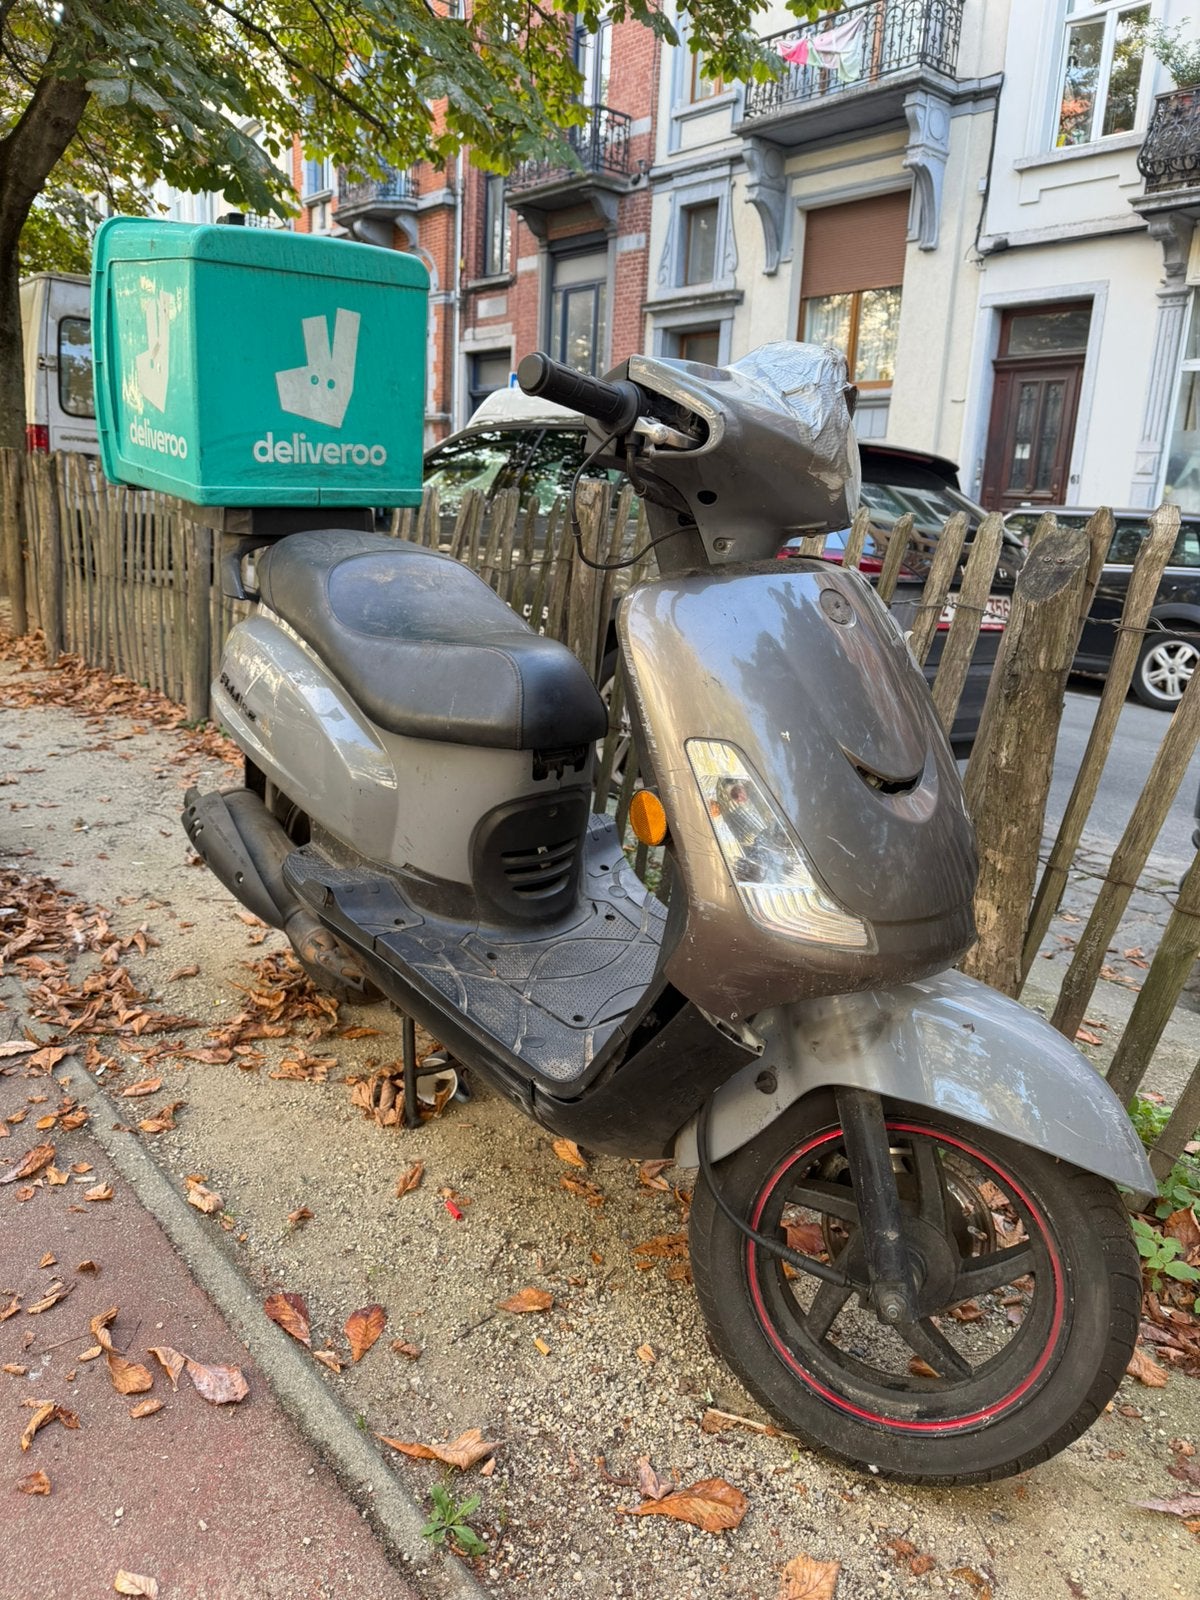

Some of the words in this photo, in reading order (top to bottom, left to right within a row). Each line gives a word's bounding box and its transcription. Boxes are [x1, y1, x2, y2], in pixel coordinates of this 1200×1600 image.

[129, 415, 188, 459] deliveroo
[253, 431, 387, 466] deliveroo
[1070, 474, 1080, 485] 61
